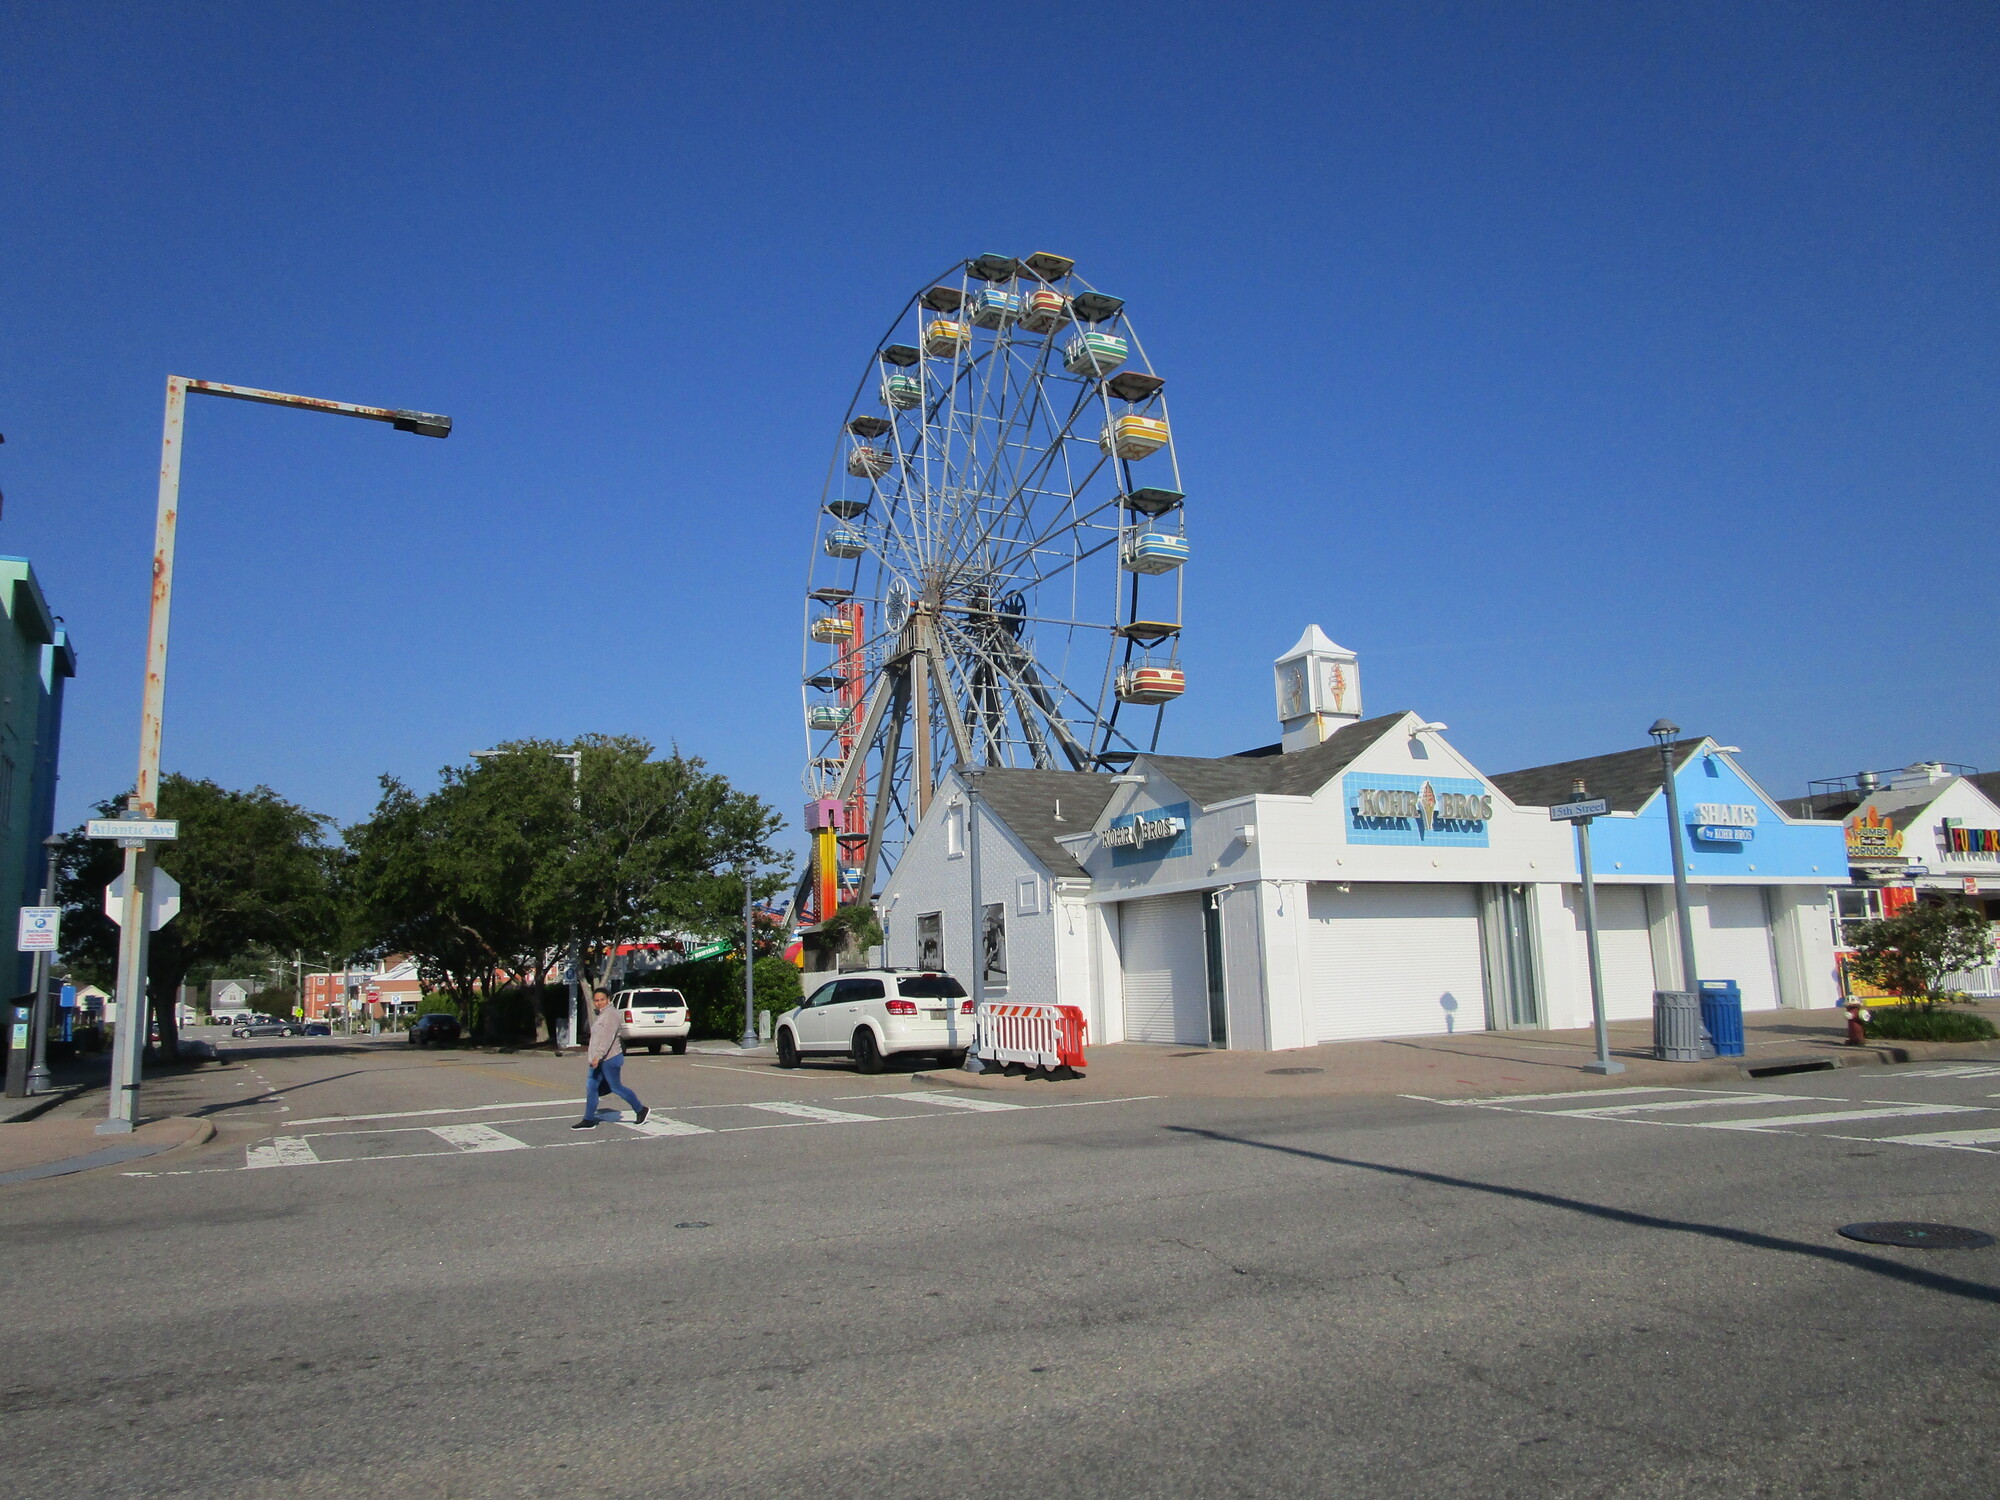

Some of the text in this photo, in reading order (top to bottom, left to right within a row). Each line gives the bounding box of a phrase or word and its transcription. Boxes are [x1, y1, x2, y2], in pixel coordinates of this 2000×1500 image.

[1357, 788, 1493, 821] KOHR BROS
[1552, 802, 1605, 817] 15th Street
[1698, 803, 1757, 827] SHAKES
[91, 823, 174, 835] Atlantic Ave
[1101, 817, 1172, 849] KOHR BROS
[1855, 828, 1889, 837] JUMBO
[1977, 828, 2000, 852] PAR
[1847, 846, 1899, 856] CORNDOGS
